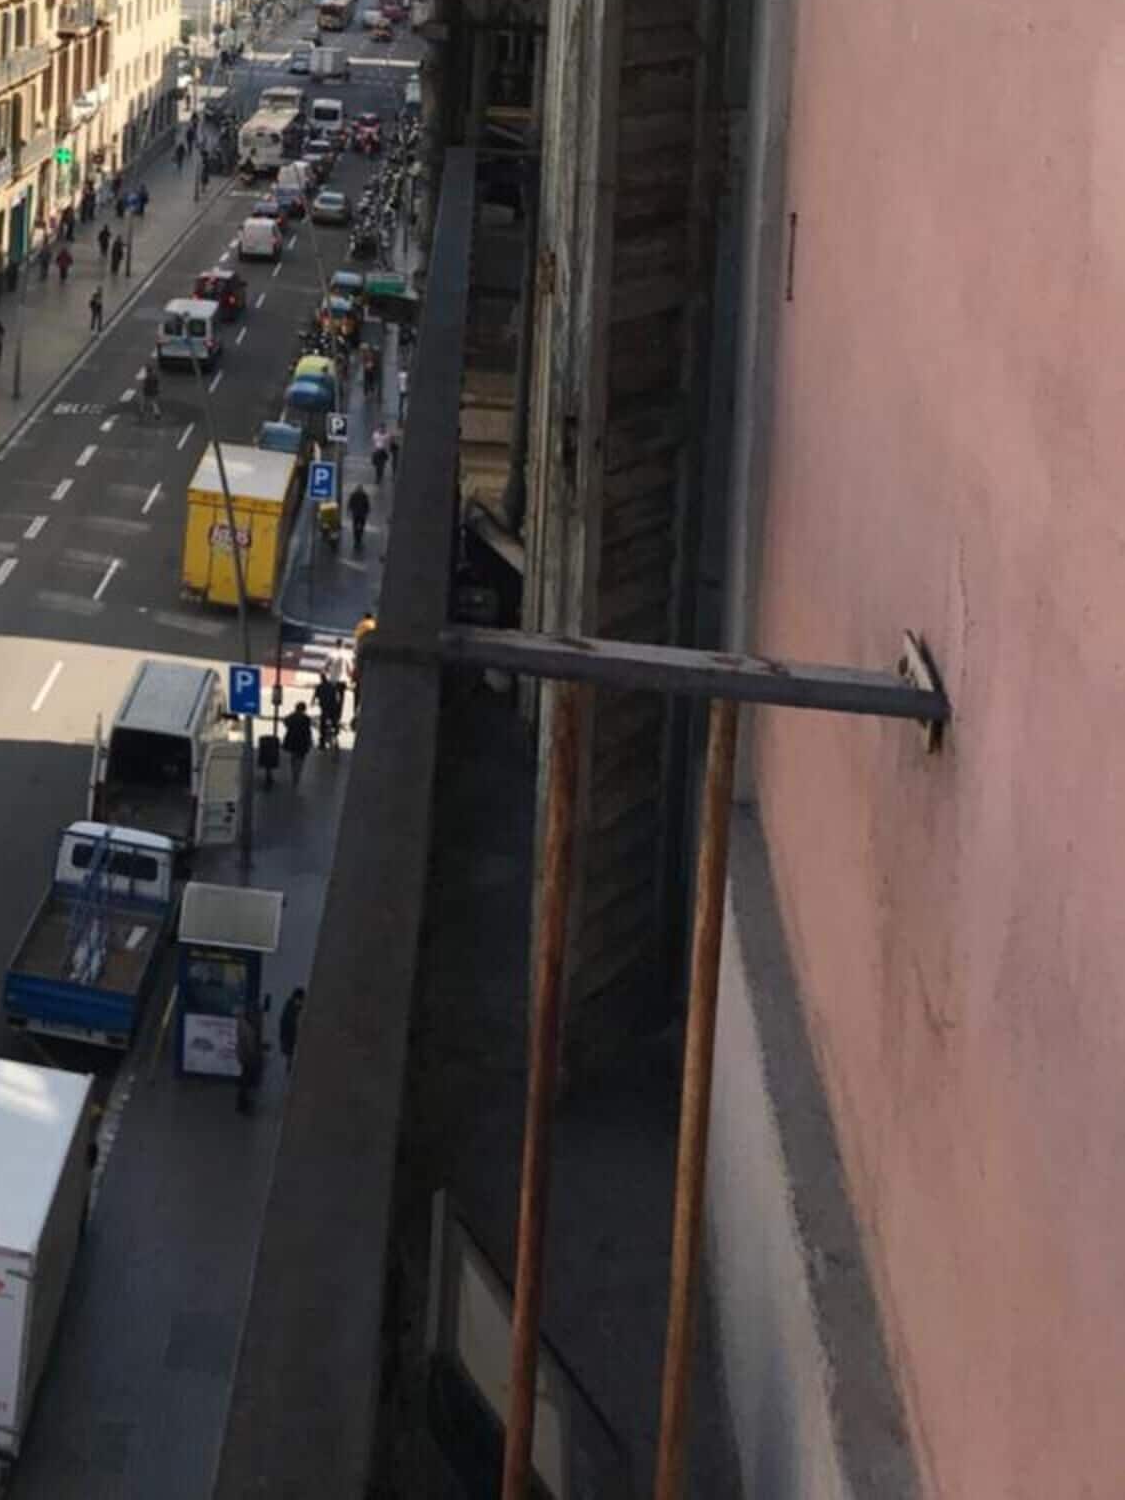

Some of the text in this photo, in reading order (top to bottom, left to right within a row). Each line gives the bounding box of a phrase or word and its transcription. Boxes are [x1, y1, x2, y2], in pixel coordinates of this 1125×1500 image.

[331, 417, 345, 434] P
[315, 467, 329, 486] P
[236, 671, 253, 692] P
